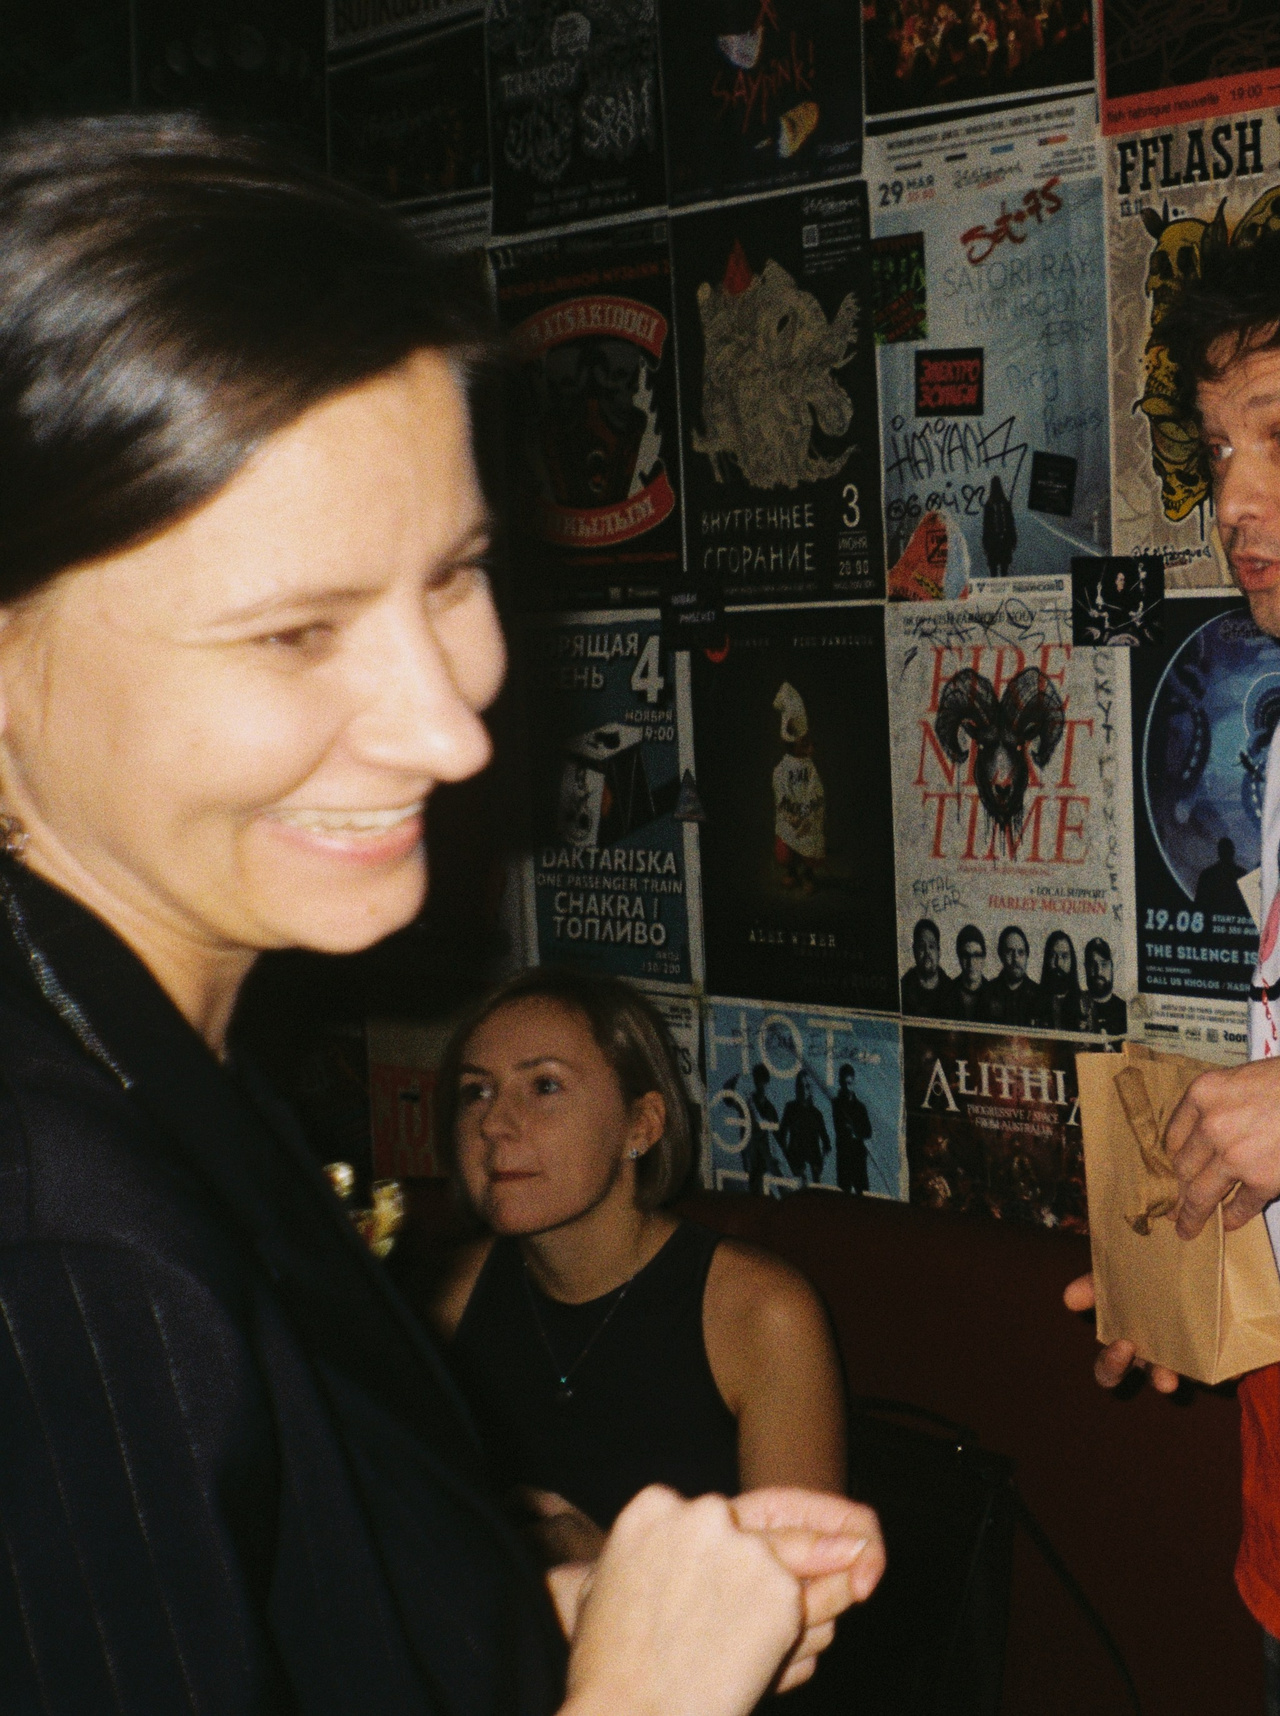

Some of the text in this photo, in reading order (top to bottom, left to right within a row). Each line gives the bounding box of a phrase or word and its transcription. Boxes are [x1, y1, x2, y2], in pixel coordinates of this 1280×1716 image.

[1117, 118, 1265, 195] FFLASH
[878, 180, 904, 207] 29
[701, 502, 816, 535] ВНУТРЕННЕЕ
[841, 483, 862, 529] 3
[702, 541, 817, 577] СГОРАНИЕ
[556, 632, 665, 704] РЯЩАЯ 4
[921, 791, 1092, 865] TIME
[541, 847, 679, 877] DAKTARISKA
[537, 873, 684, 896] ONE PASSENGER TRAIN
[1066, 886, 1108, 900] SUPPORT
[554, 891, 647, 921] CHAKRA
[988, 895, 1038, 911] HARLEY
[552, 916, 669, 948] ТОПЛИВО
[1144, 908, 1205, 934] 19.08
[1144, 943, 1173, 960] THE
[1177, 945, 1241, 964] SILENCE
[1145, 975, 1168, 986] CALL
[966, 1103, 1026, 1121] PROGRESSIVE
